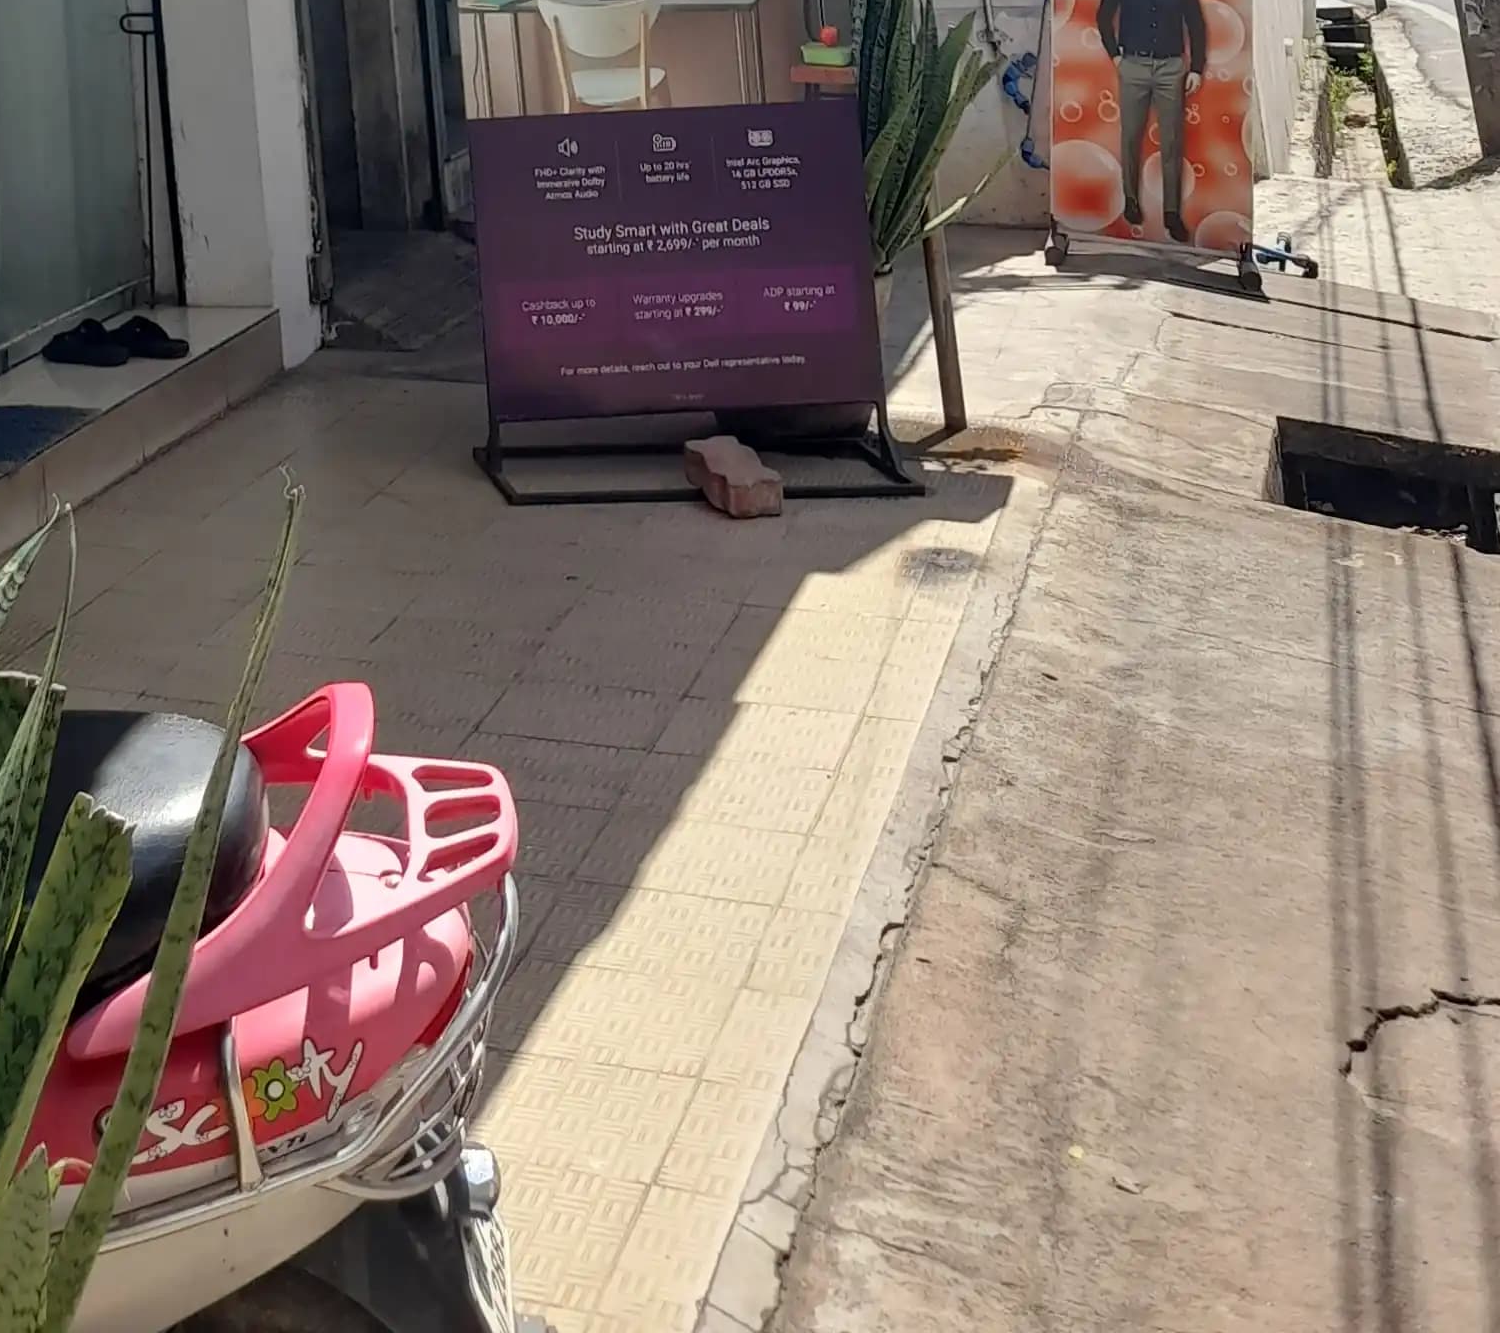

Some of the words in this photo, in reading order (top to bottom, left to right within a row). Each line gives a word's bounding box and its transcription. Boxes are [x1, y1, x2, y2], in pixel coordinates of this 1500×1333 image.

[574, 225, 613, 242] Study
[615, 223, 657, 239] Smart
[659, 221, 689, 236] with
[691, 219, 729, 235] Great
[731, 217, 771, 233] Deals
[586, 240, 631, 256] starting
[633, 241, 645, 253] at
[702, 237, 720, 251] per
[723, 234, 761, 248] month
[571, 299, 584, 310] up
[585, 297, 597, 308] to
[632, 293, 677, 306] Warranty
